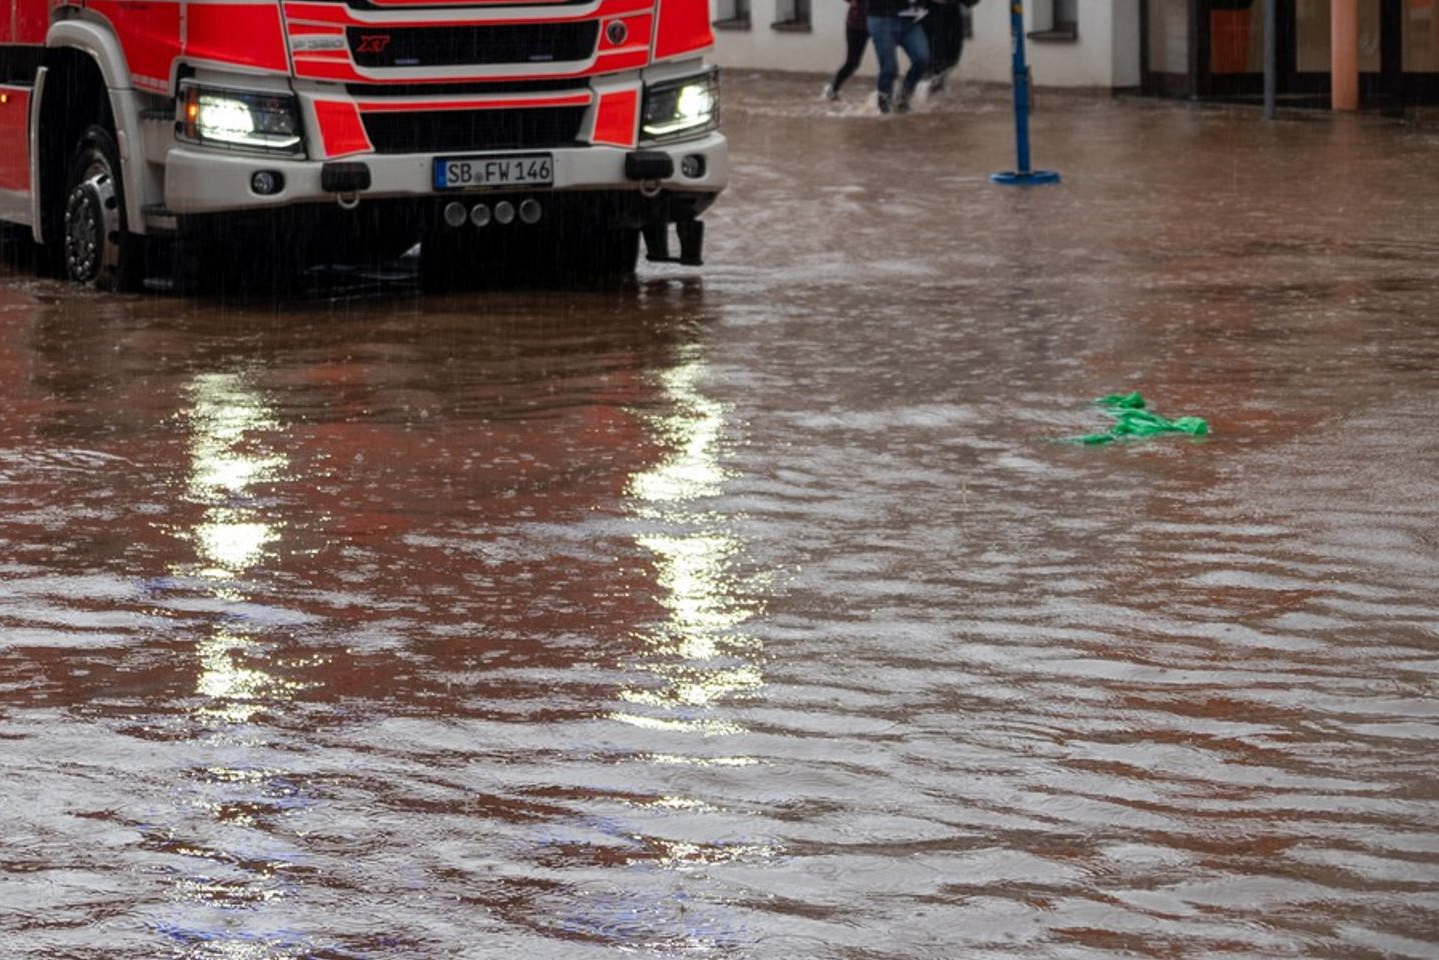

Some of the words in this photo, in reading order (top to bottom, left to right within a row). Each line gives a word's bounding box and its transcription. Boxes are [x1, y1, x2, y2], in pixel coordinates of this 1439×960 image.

[448, 163, 472, 183] SB
[485, 162, 510, 182] FW
[515, 160, 550, 180] 146
